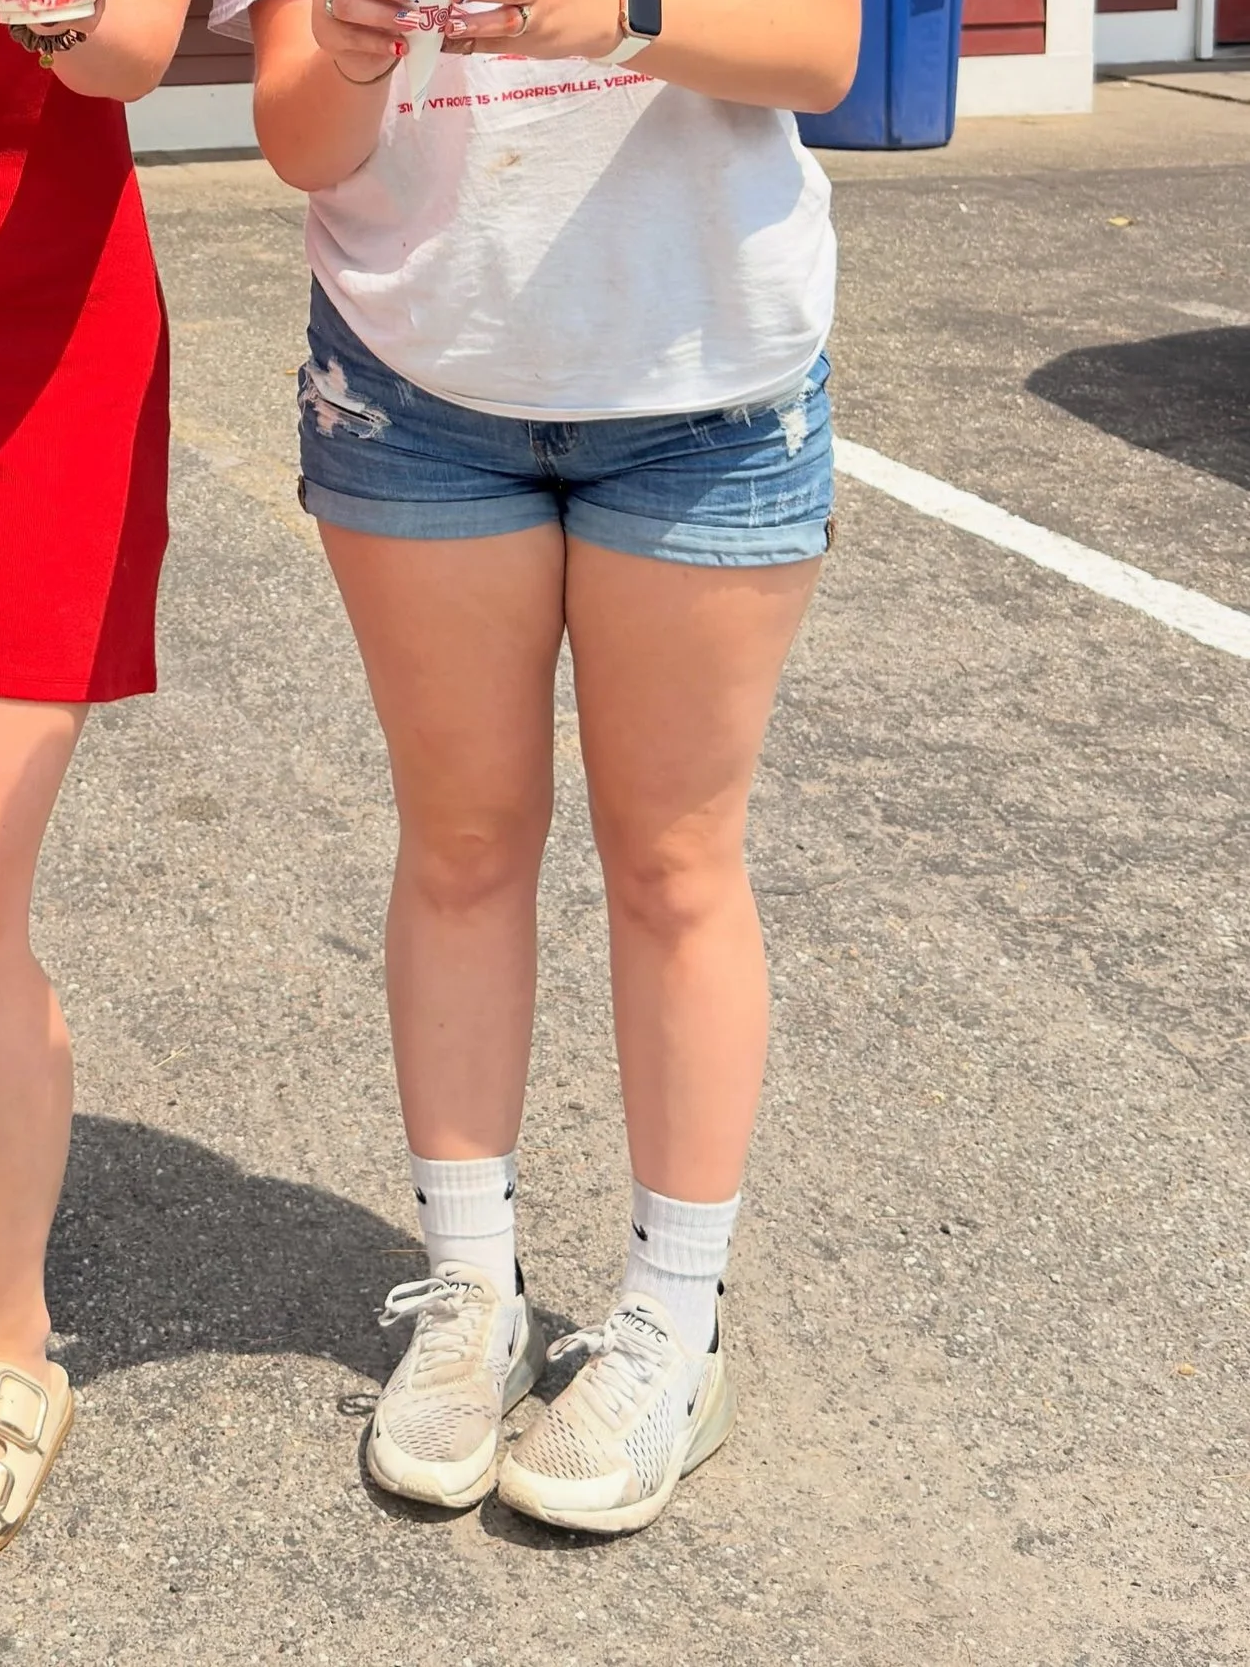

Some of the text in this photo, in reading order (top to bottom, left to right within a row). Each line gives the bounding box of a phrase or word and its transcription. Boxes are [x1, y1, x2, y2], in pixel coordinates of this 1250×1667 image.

[429, 98, 444, 110] VT
[477, 94, 490, 105] 15
[502, 79, 600, 102] MORRISVILLE,
